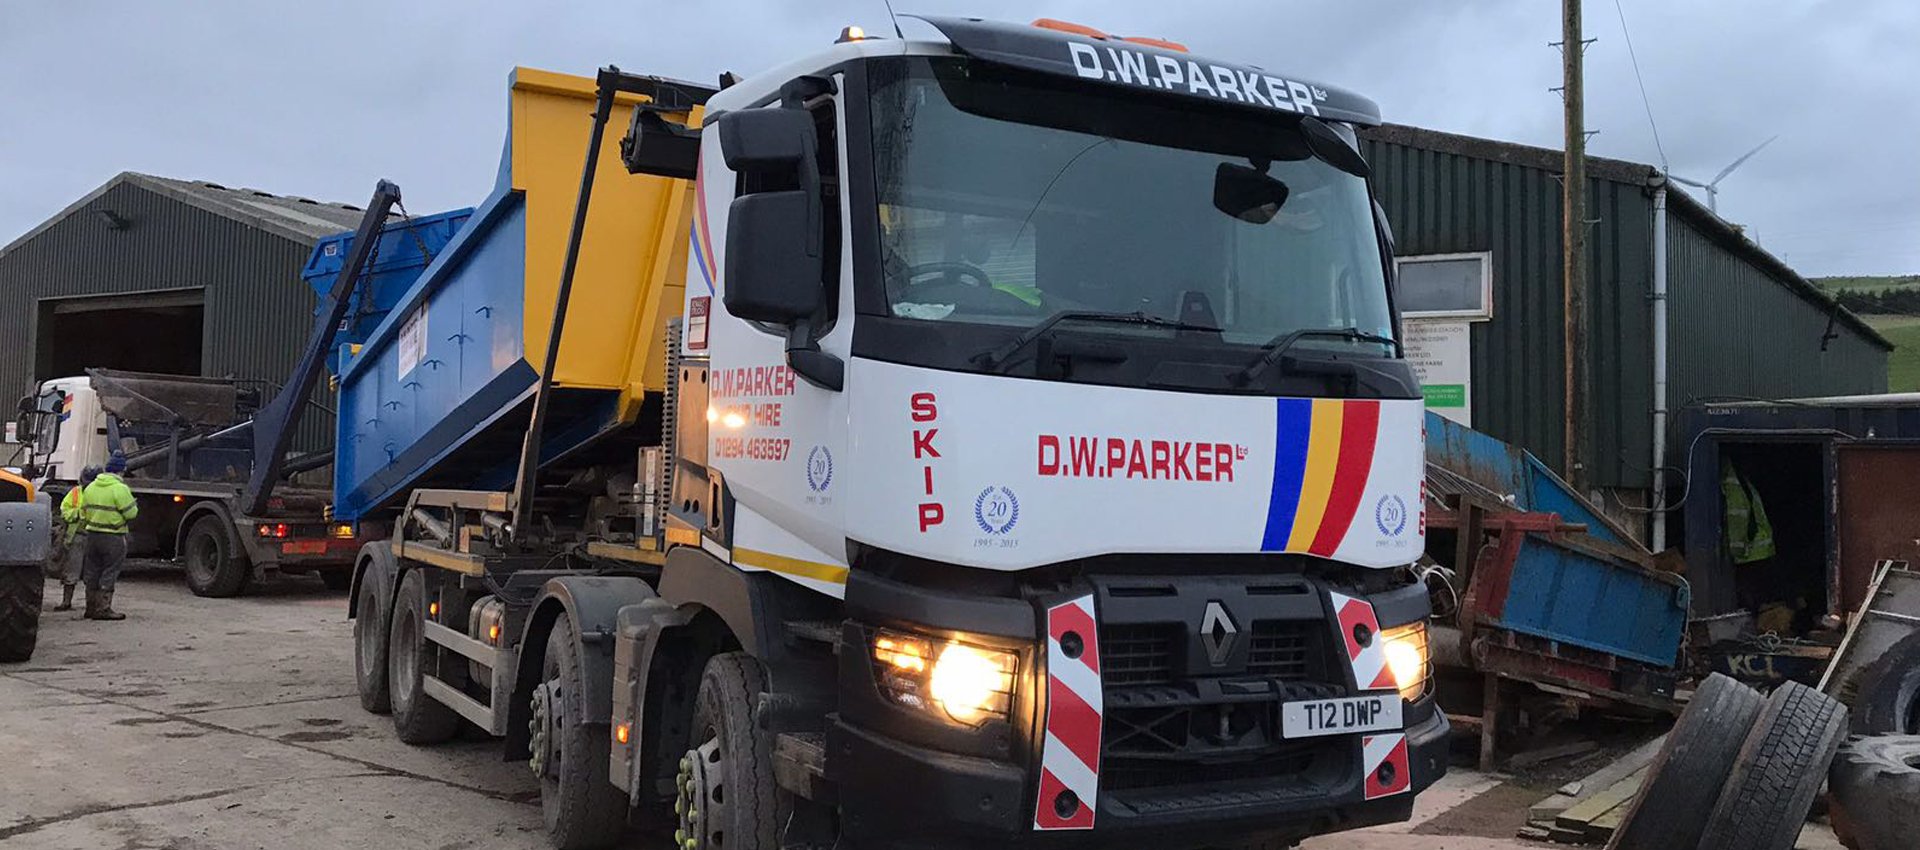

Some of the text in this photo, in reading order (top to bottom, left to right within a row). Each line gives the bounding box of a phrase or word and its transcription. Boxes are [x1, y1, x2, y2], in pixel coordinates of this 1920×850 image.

[1067, 42, 1320, 116] D.W.PARKER
[711, 366, 796, 398] D.W.PARKER
[754, 403, 781, 427] HIRE
[746, 437, 791, 461] 463597
[911, 392, 944, 533] SKIP
[1038, 435, 1249, 482] D.W.PARKER Ltd
[813, 459, 825, 475] 20
[987, 501, 1007, 517] 20
[1384, 508, 1399, 522] 20
[1303, 699, 1382, 730] T12 DWP
